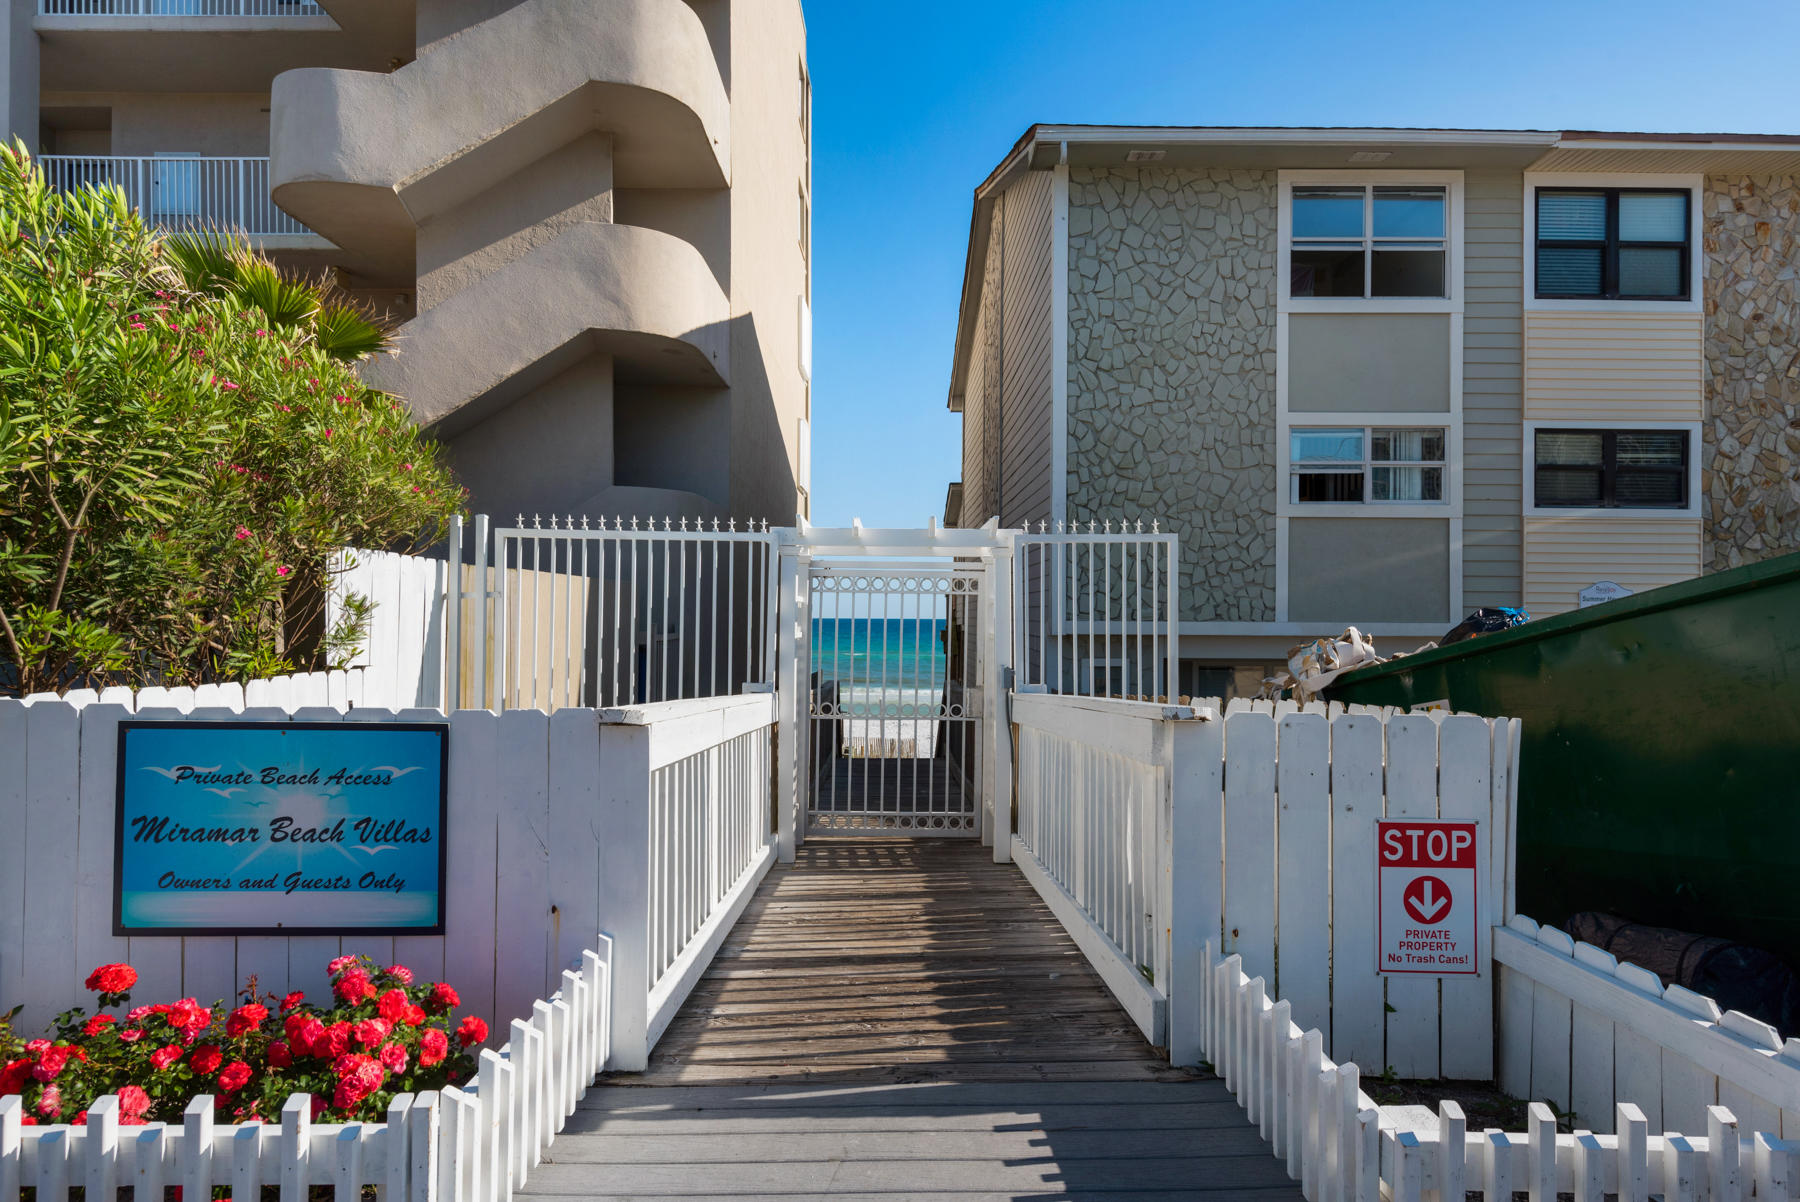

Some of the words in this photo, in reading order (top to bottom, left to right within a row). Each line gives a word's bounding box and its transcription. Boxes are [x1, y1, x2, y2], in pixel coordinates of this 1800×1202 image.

[174, 766, 252, 784] Private
[260, 767, 320, 785] Beach
[323, 768, 392, 785] Access
[131, 815, 260, 843] Miramar
[269, 816, 346, 843] Beach
[354, 816, 432, 843] Villas
[1383, 829, 1472, 862] STOP
[158, 871, 231, 889] Owners
[239, 873, 278, 889] and
[284, 871, 351, 895] Guests
[358, 871, 406, 894] Only
[1405, 929, 1451, 940] PRIVATE
[1399, 941, 1457, 951] PROPERTY
[1388, 953, 1402, 963] No
[1405, 953, 1435, 964] Trash
[1438, 954, 1468, 964] Cans!
